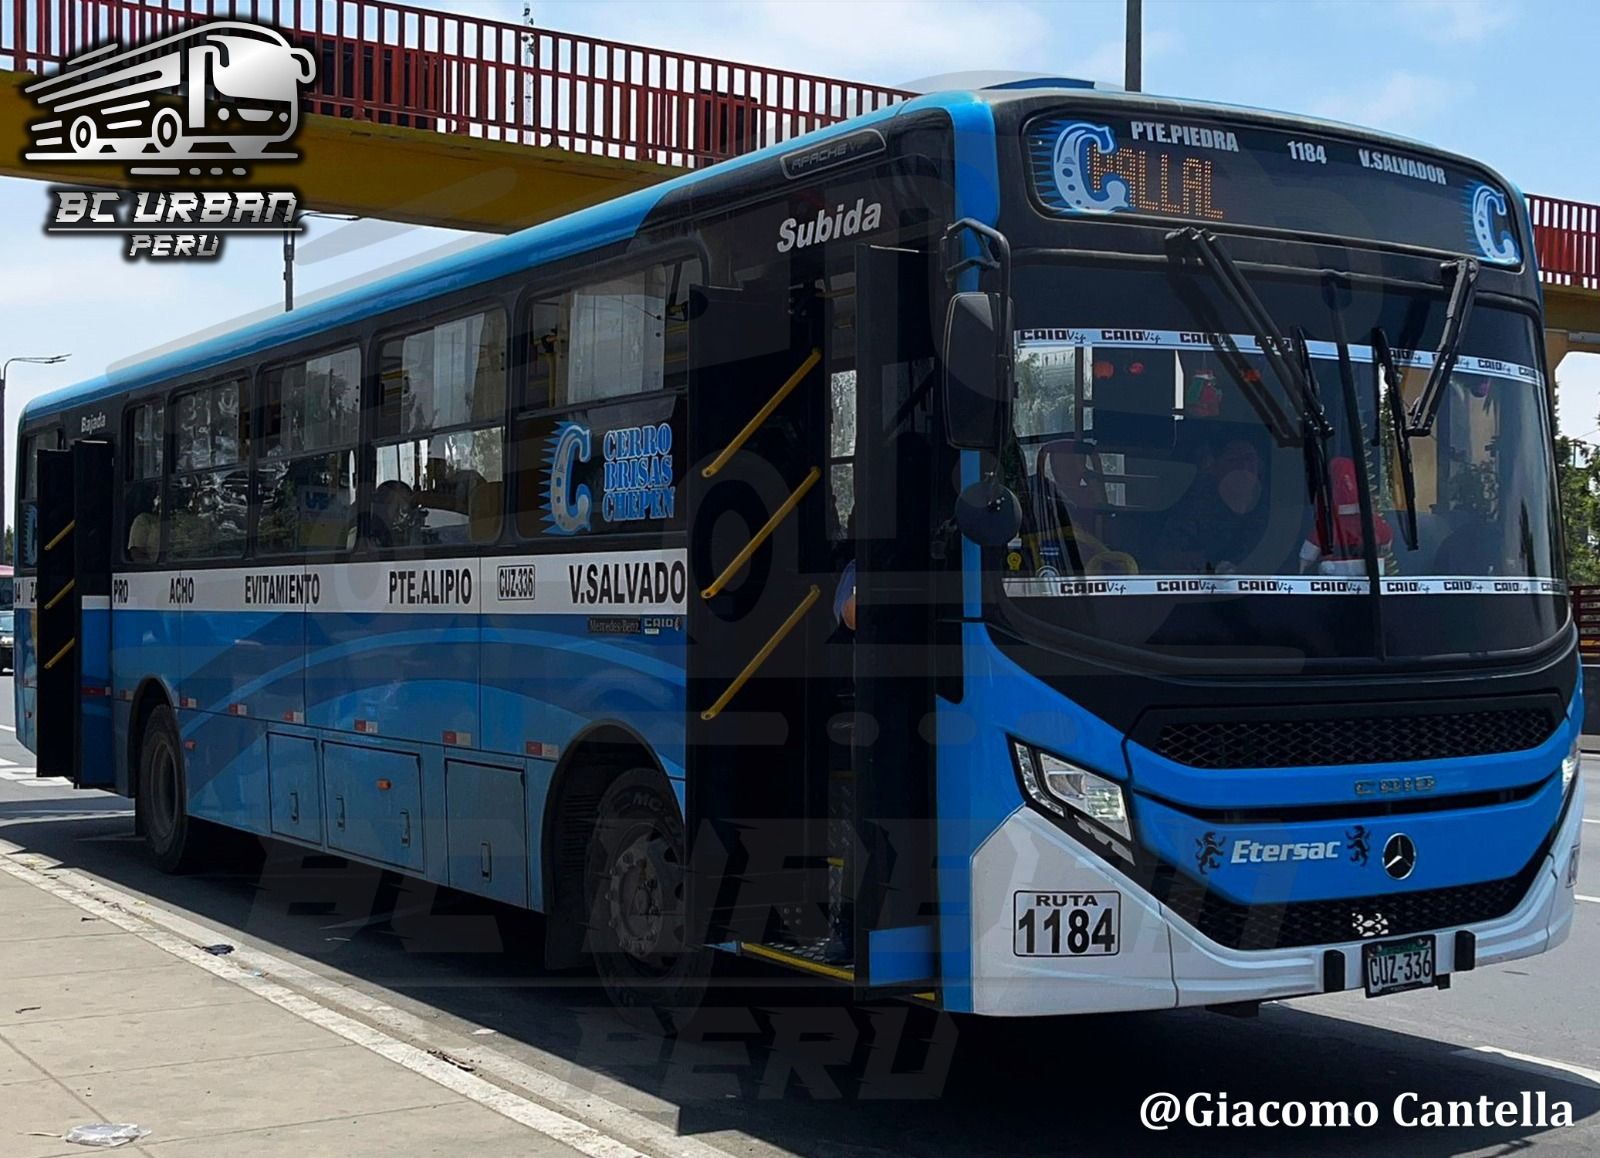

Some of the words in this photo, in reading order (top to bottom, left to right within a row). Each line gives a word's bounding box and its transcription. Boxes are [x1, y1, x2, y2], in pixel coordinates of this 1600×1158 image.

[791, 143, 848, 170] APACHE
[1131, 121, 1240, 153] PTE.PIEDRA
[1287, 140, 1328, 164] 1184
[1358, 148, 1447, 185] V.SALVADOR
[776, 199, 882, 254] Subida
[1020, 329, 1068, 341] CAIO
[1101, 330, 1144, 341] CAIO
[81, 411, 106, 435] Bajada
[603, 422, 673, 461] CERRO
[603, 455, 673, 492] BRISAS
[113, 578, 129, 605] PRO
[169, 577, 195, 604] ACHO
[244, 575, 321, 604] EVITAMIENTO
[389, 569, 473, 605] PTE.ALIPIO
[498, 568, 535, 598] CUZ-336
[1060, 582, 1107, 595] CAIO
[1157, 581, 1200, 592] CAIO
[1238, 581, 1277, 592] CAIO
[644, 617, 673, 628] CAIO
[1230, 838, 1342, 864] Etersac
[1035, 894, 1098, 907] RUTA
[1018, 908, 1115, 954] 1184
[1370, 949, 1432, 987] CUZ-336
